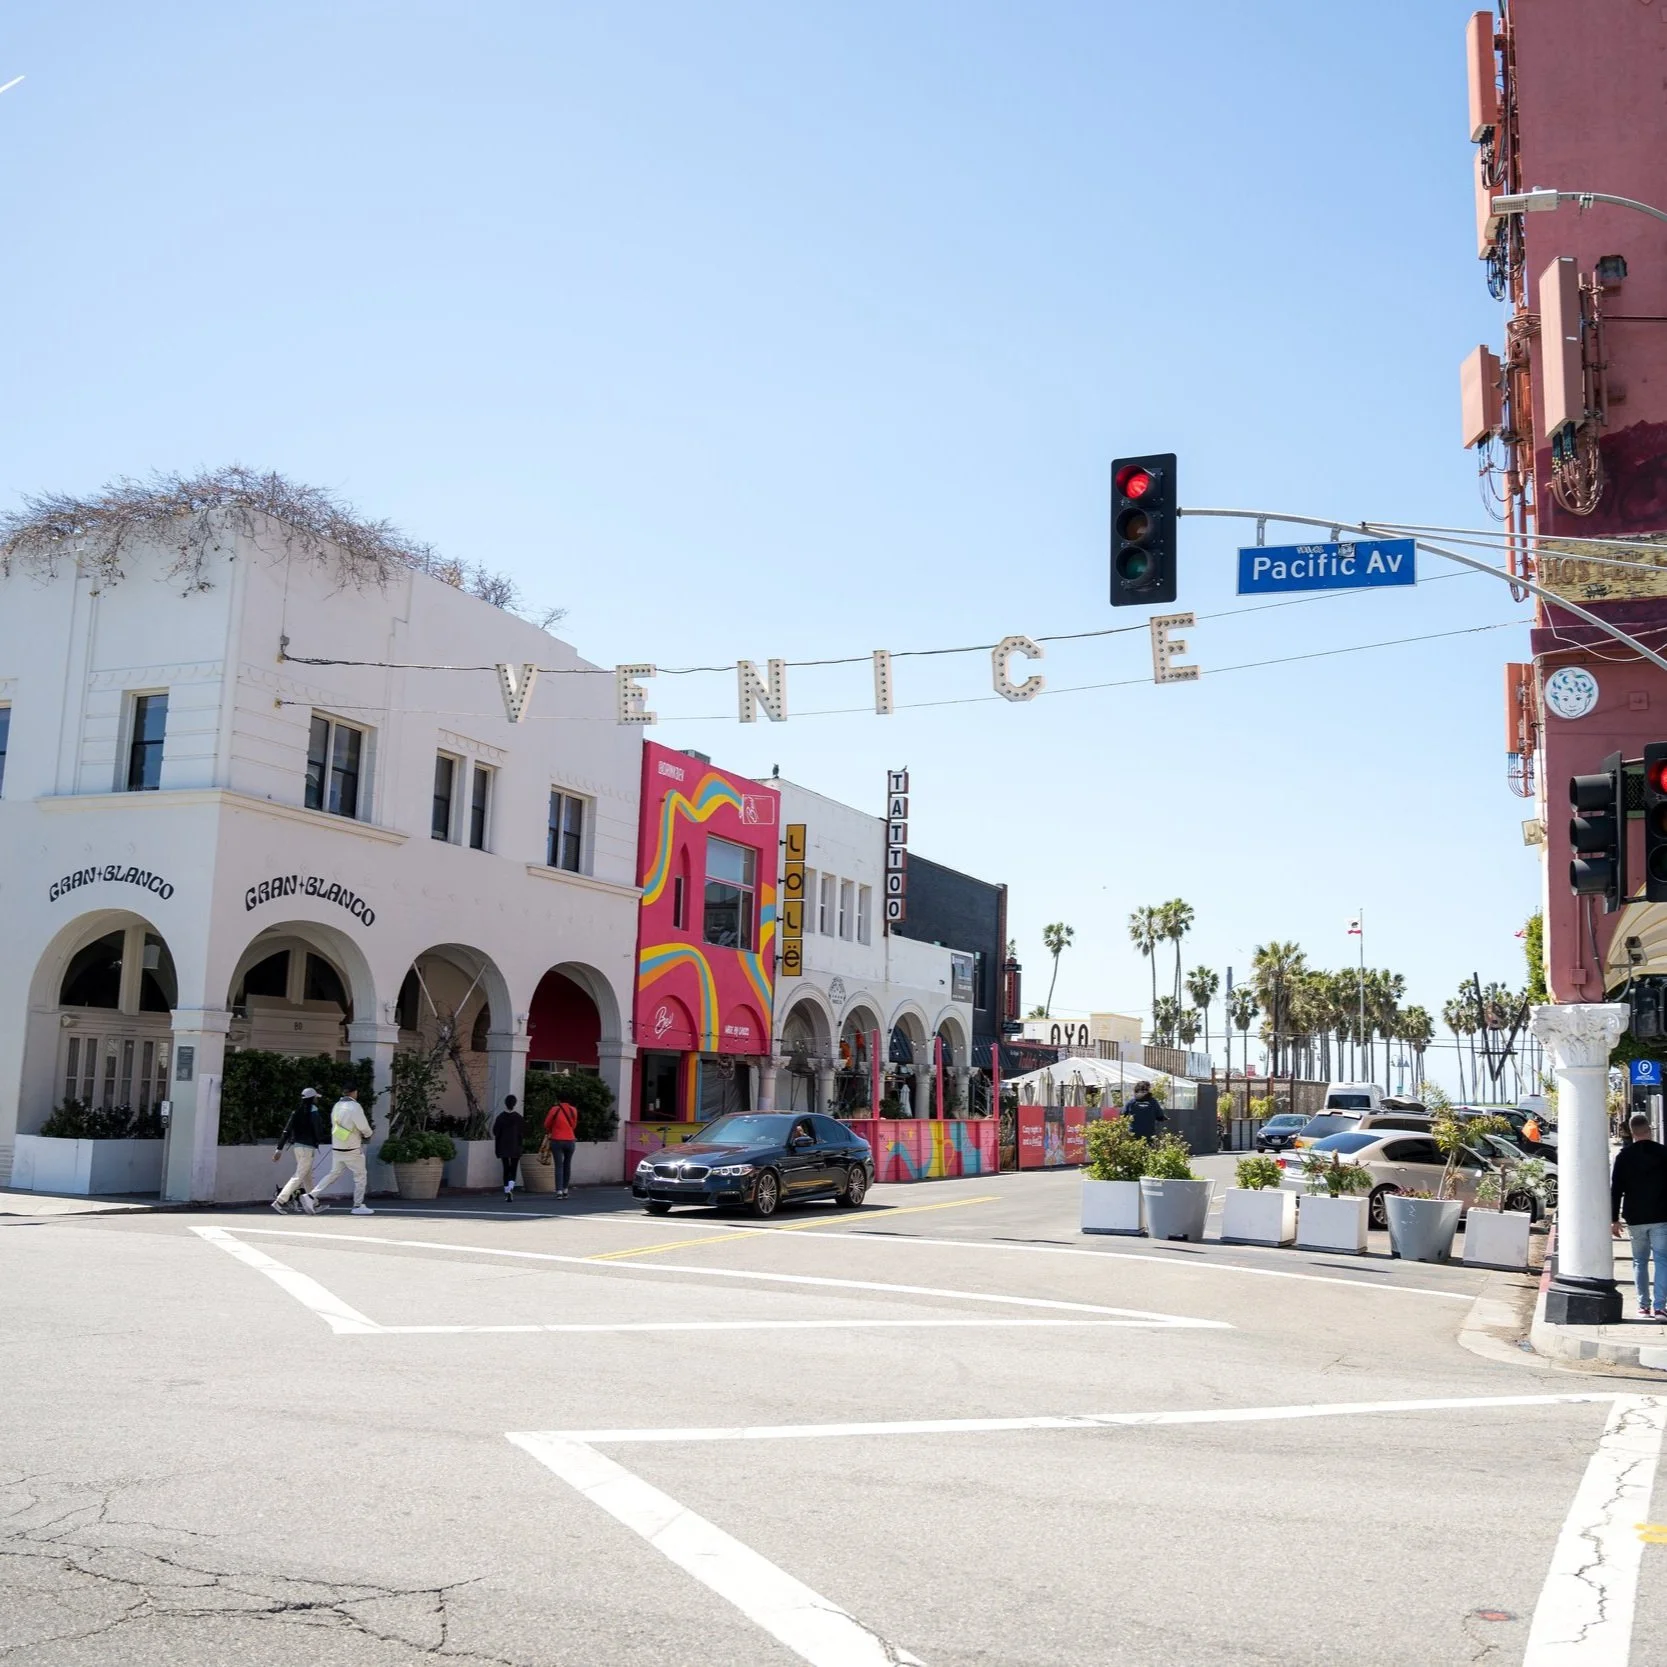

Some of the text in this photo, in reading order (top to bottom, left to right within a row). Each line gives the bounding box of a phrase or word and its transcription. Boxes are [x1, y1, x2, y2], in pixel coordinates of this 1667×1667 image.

[1252, 552, 1356, 581] Pacific
[1366, 550, 1403, 575] Av
[495, 612, 1200, 726] VENICE
[888, 773, 904, 918] TATTOO
[49, 864, 175, 903] GRAN BLANCO
[244, 874, 377, 927] GRAN BLANCO
[1050, 1023, 1089, 1046] AYA
